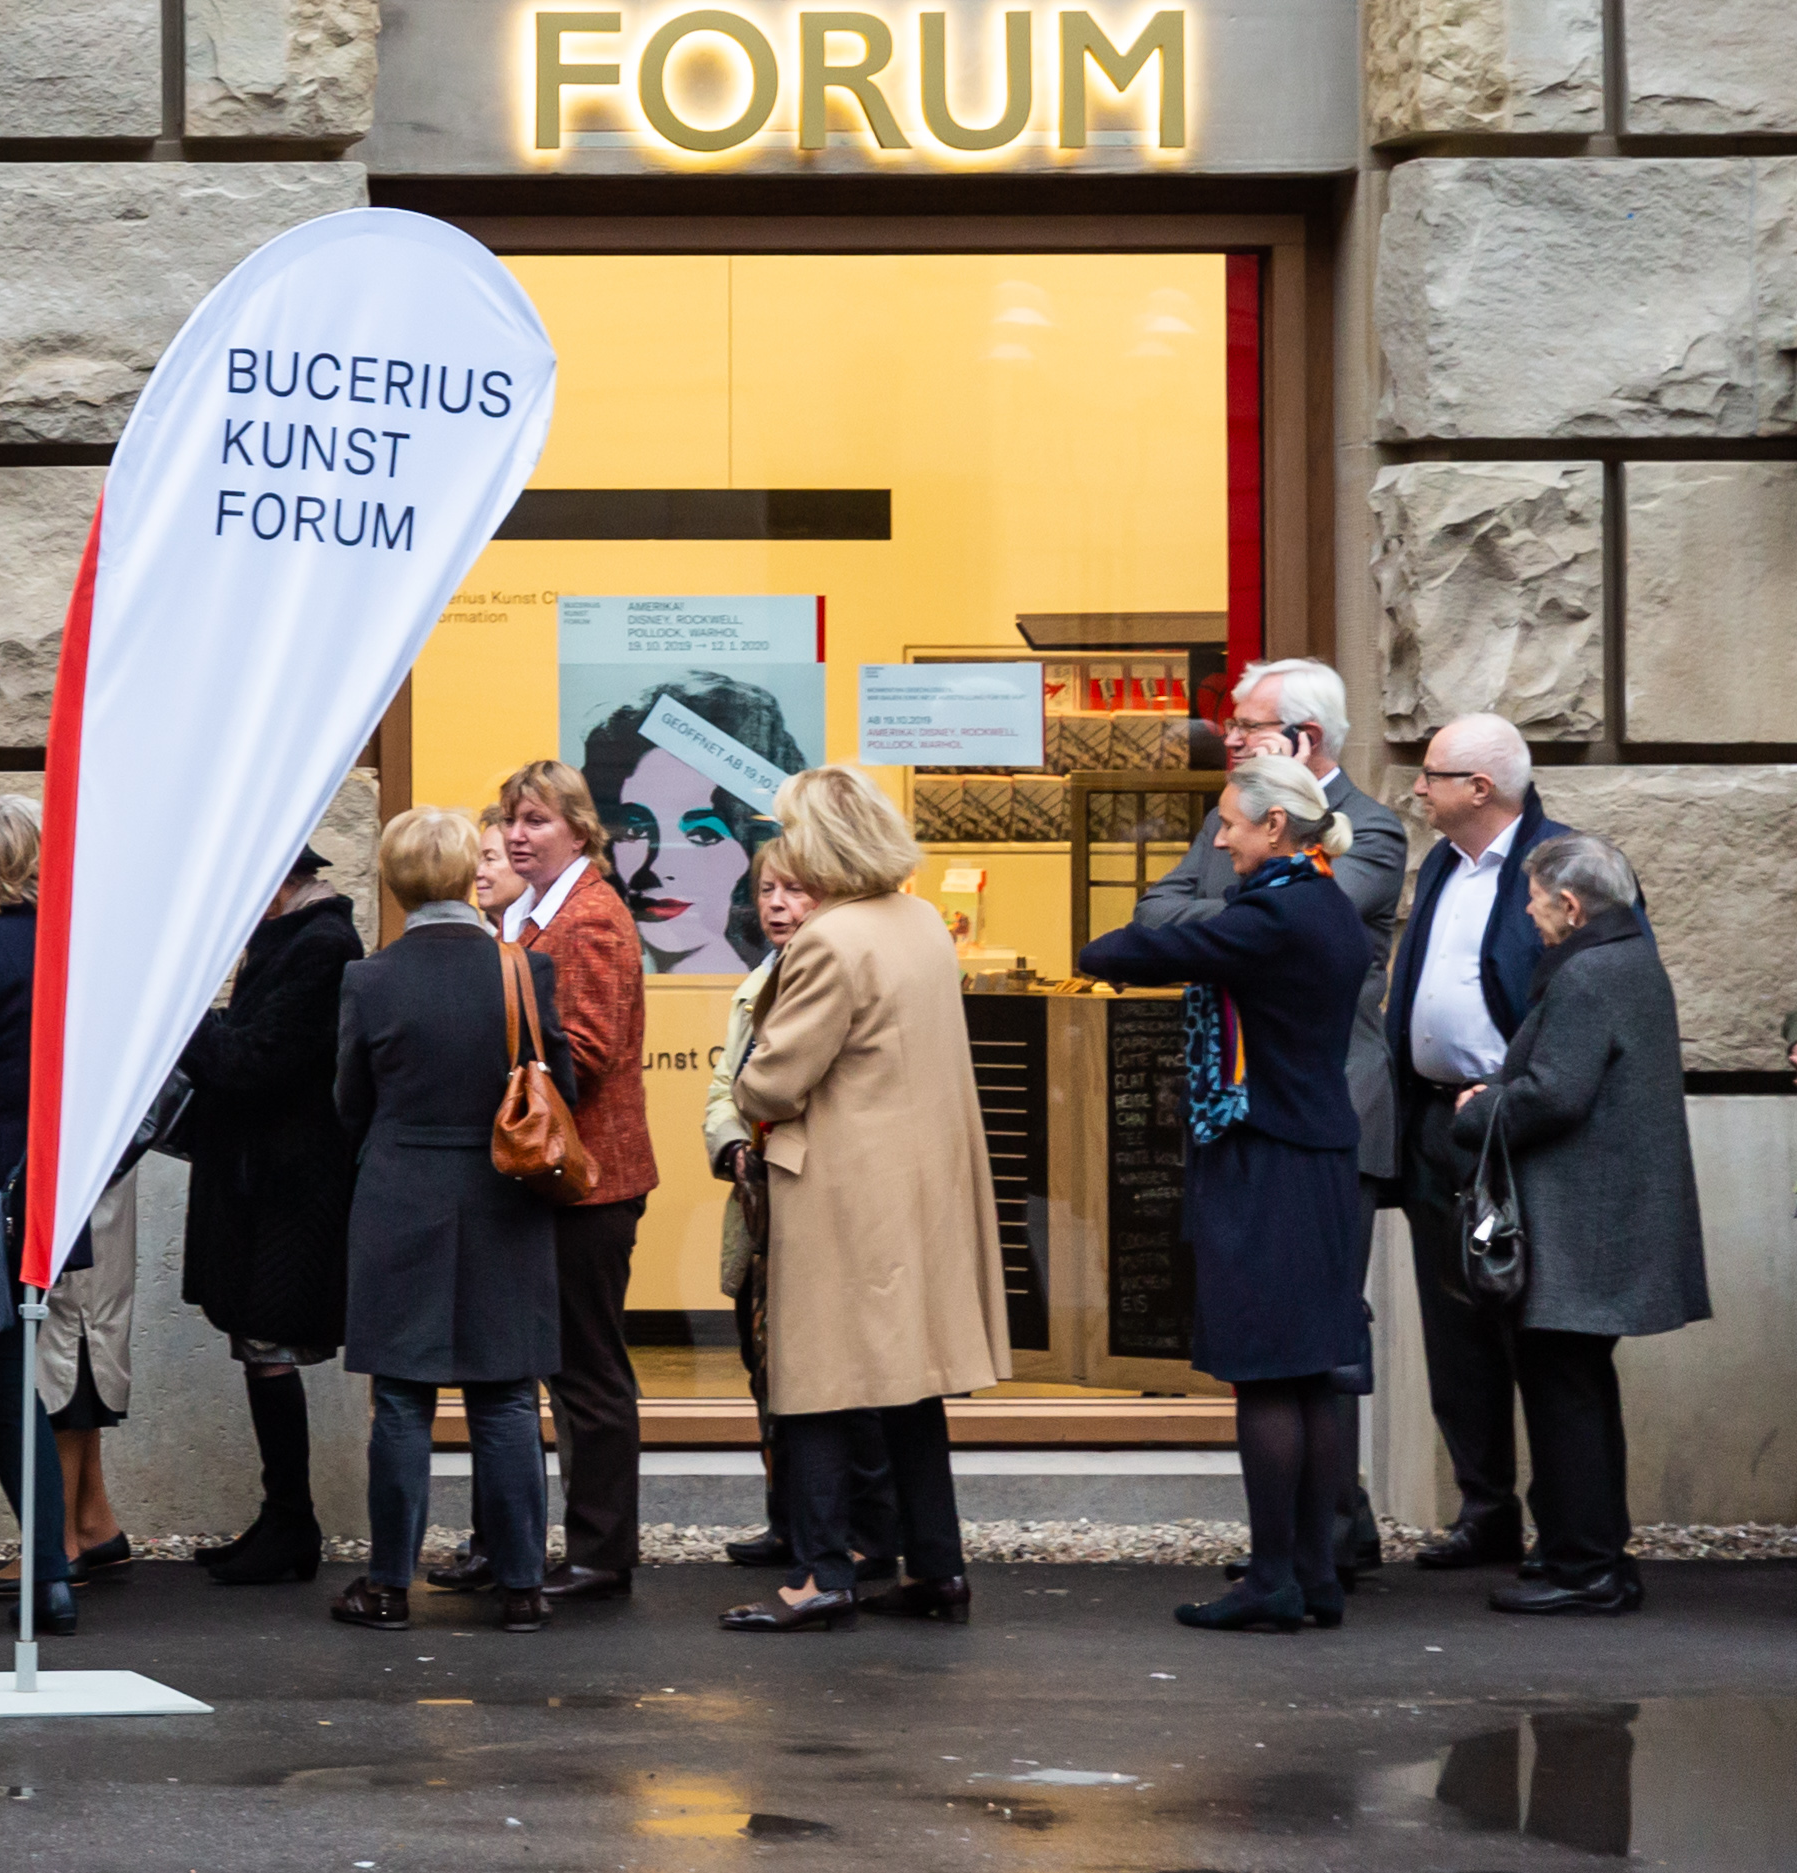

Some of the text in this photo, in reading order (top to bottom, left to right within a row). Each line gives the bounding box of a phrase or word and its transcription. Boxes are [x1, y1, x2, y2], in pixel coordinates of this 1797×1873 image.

[536, 10, 1185, 151] FORUM
[227, 348, 513, 418] BUCERIUS
[222, 418, 410, 477] KUNST
[215, 490, 415, 551] FORUM
[448, 591, 486, 604] erius
[491, 591, 537, 605] Kunst
[438, 610, 508, 624] ormation
[628, 615, 672, 625] DISNEY,
[690, 628, 739, 637] WARHOL
[723, 754, 743, 771] AB
[642, 1048, 698, 1070] unst
